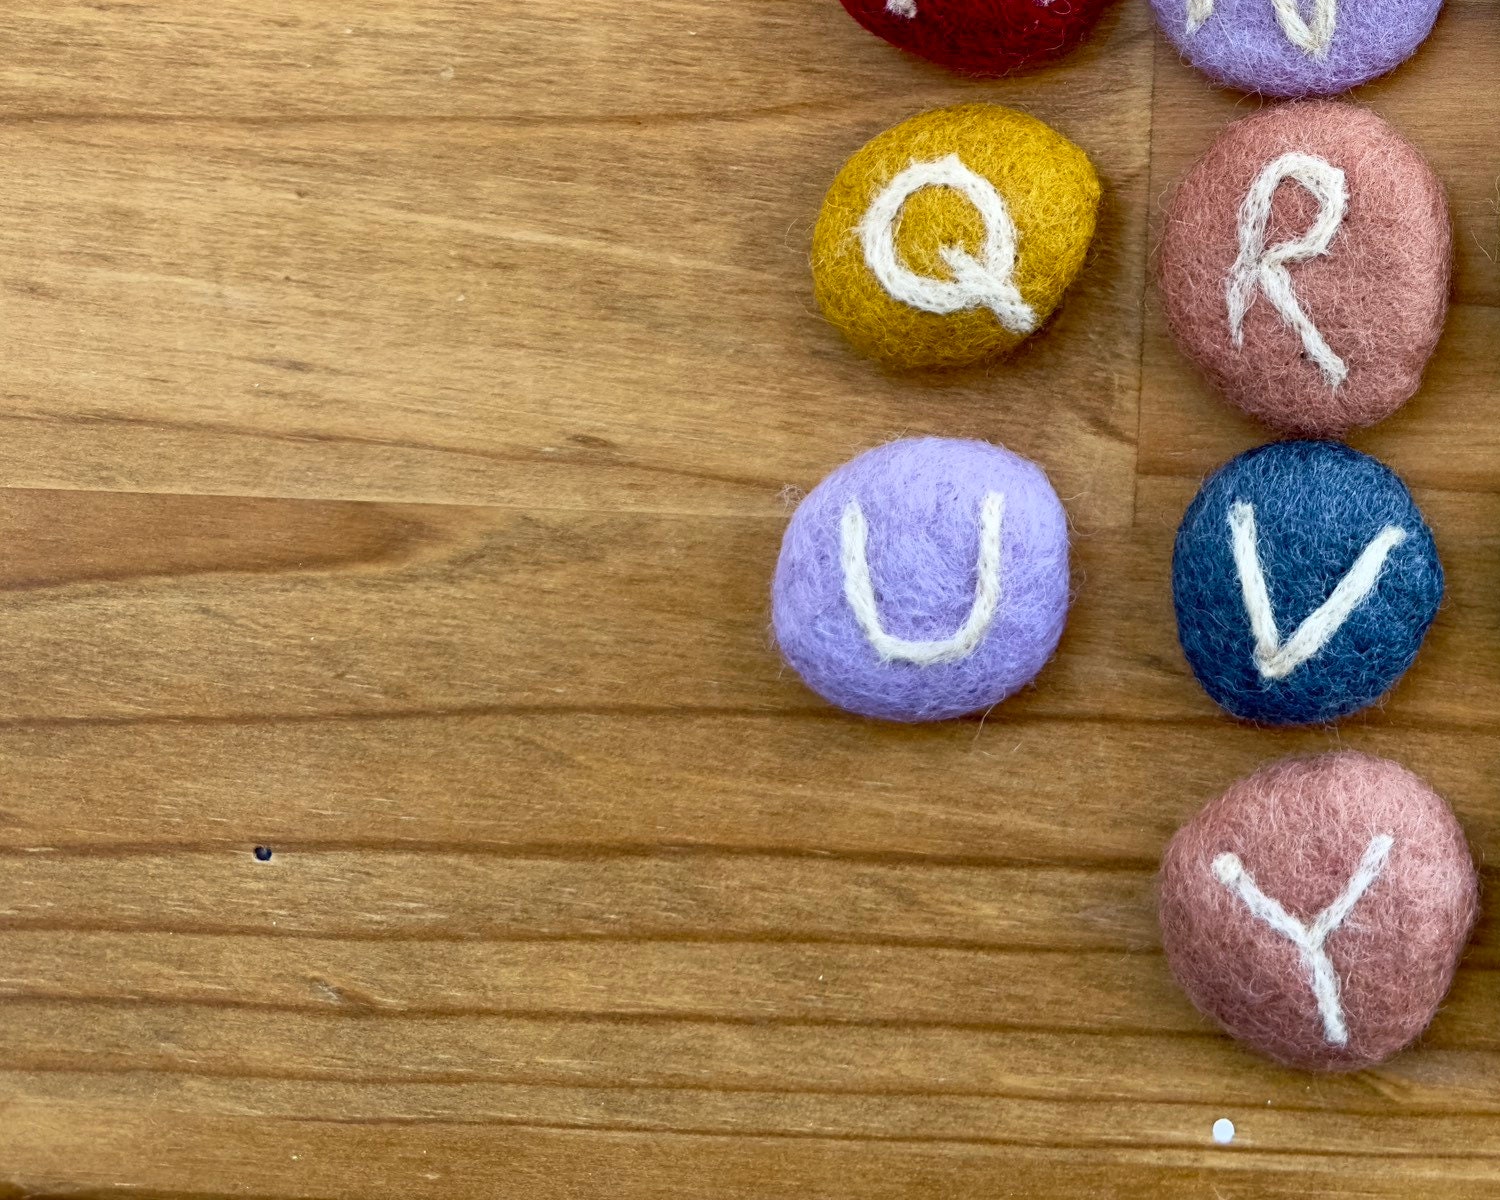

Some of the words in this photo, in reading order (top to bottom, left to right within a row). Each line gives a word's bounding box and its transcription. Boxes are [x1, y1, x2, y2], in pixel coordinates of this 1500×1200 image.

[858, 155, 1036, 331] Q
[1227, 151, 1350, 388] R
[842, 490, 1006, 660] U
[1228, 503, 1406, 677] V
[1212, 833, 1394, 1042] Y
